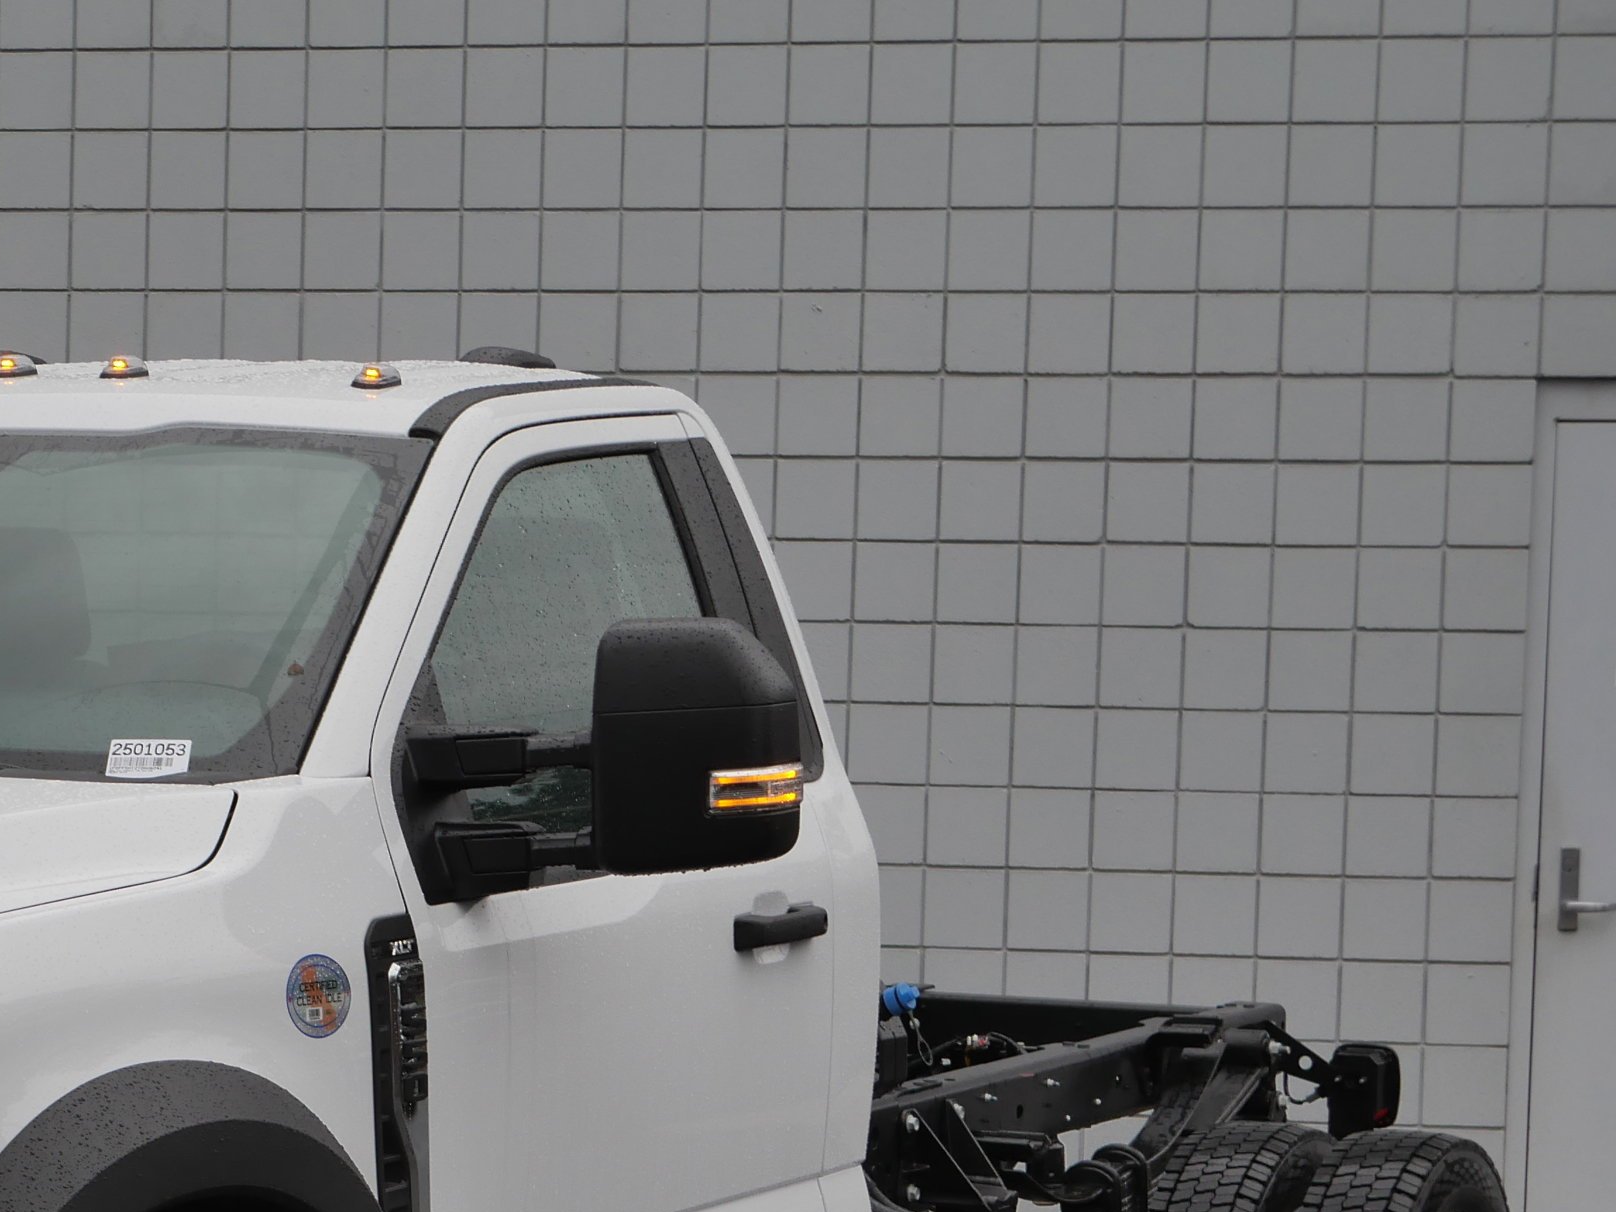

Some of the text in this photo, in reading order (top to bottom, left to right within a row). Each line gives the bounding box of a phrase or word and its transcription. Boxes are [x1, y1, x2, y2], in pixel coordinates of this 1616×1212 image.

[111, 742, 186, 757] 2501053
[389, 939, 414, 956] XLT
[299, 980, 338, 993] CERTIFIED
[296, 994, 323, 1007] CLEAN
